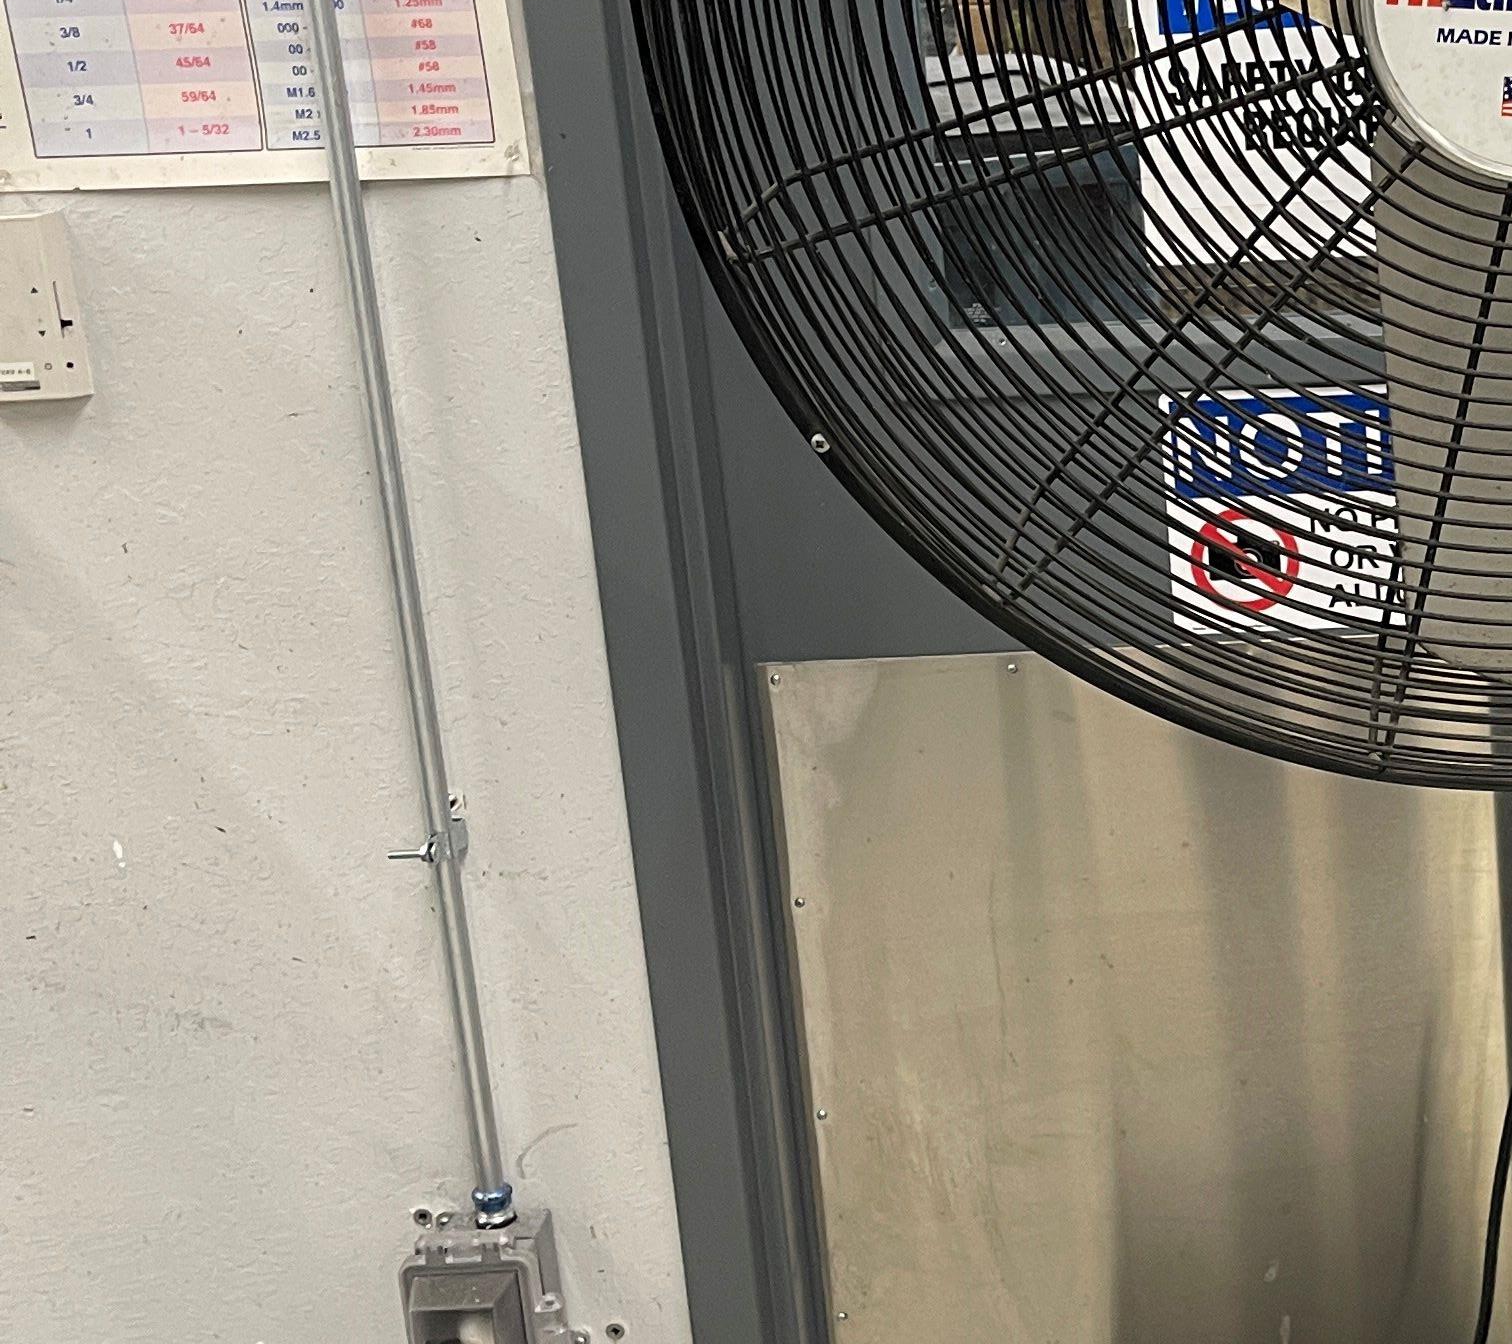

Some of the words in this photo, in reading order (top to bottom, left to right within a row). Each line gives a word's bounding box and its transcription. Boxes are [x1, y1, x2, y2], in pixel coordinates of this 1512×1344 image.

[263, 1, 304, 11] 1.4mm
[60, 26, 81, 38] 3/8
[1436, 28, 1502, 47] MADE
[67, 60, 87, 72] 1/2
[73, 94, 94, 106] 3/4
[86, 128, 92, 139] 1
[202, 123, 230, 135] 5/32
[1177, 409, 1383, 483] NOTI
[1330, 544, 1380, 569] OR
